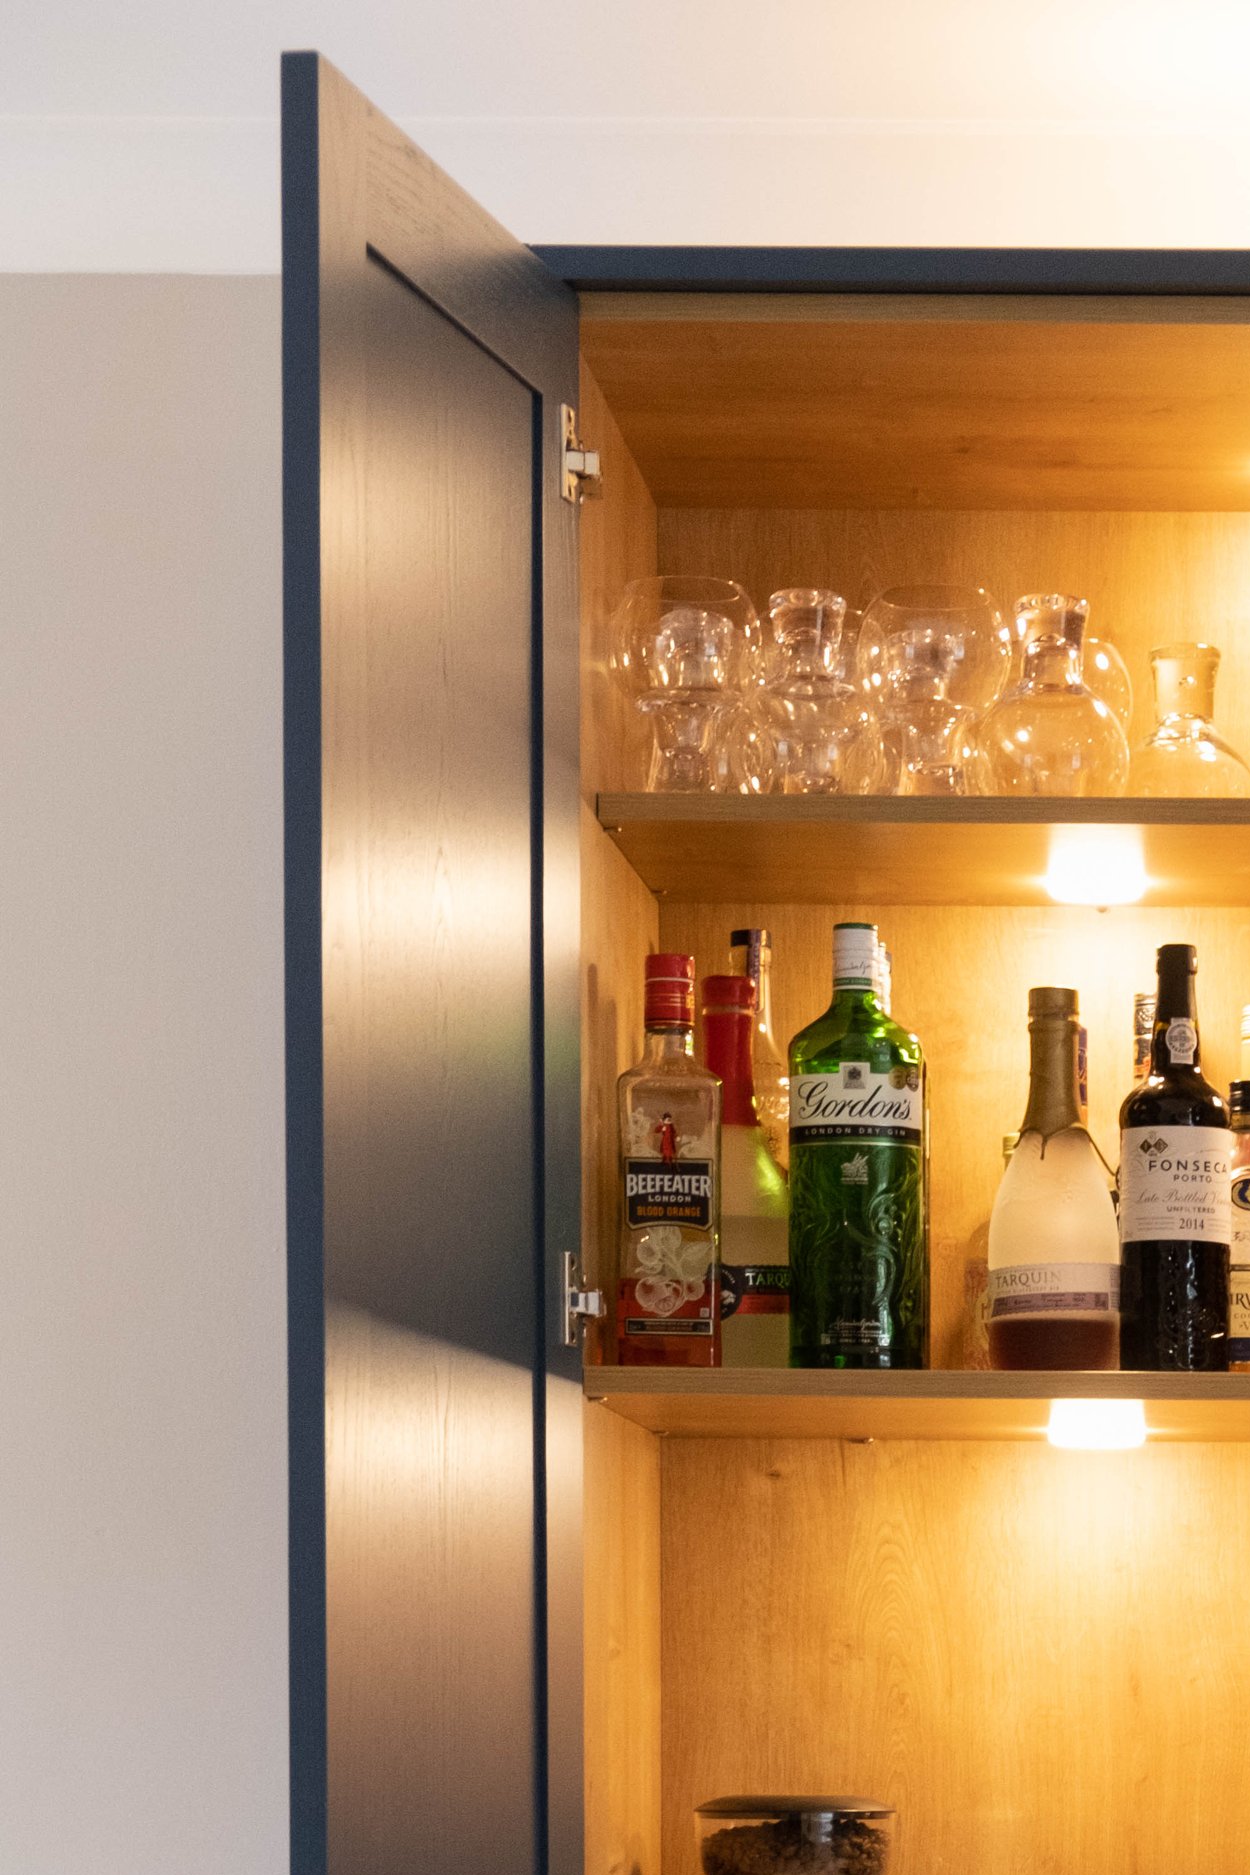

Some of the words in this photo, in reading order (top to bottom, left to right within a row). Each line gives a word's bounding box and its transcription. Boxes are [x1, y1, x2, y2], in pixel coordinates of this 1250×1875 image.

[798, 1081, 911, 1120] Gordon's
[805, 1127, 852, 1135] LONDON
[859, 1127, 880, 1135] DRY
[1148, 1159, 1228, 1174] FONSECA
[1173, 1174, 1213, 1183] PORTO
[626, 1173, 712, 1199] BEEFEATER
[648, 1195, 692, 1203] LONDON
[637, 1206, 665, 1217] BLOOD
[667, 1206, 701, 1218] ORANGE
[1179, 1217, 1205, 1230] 2014
